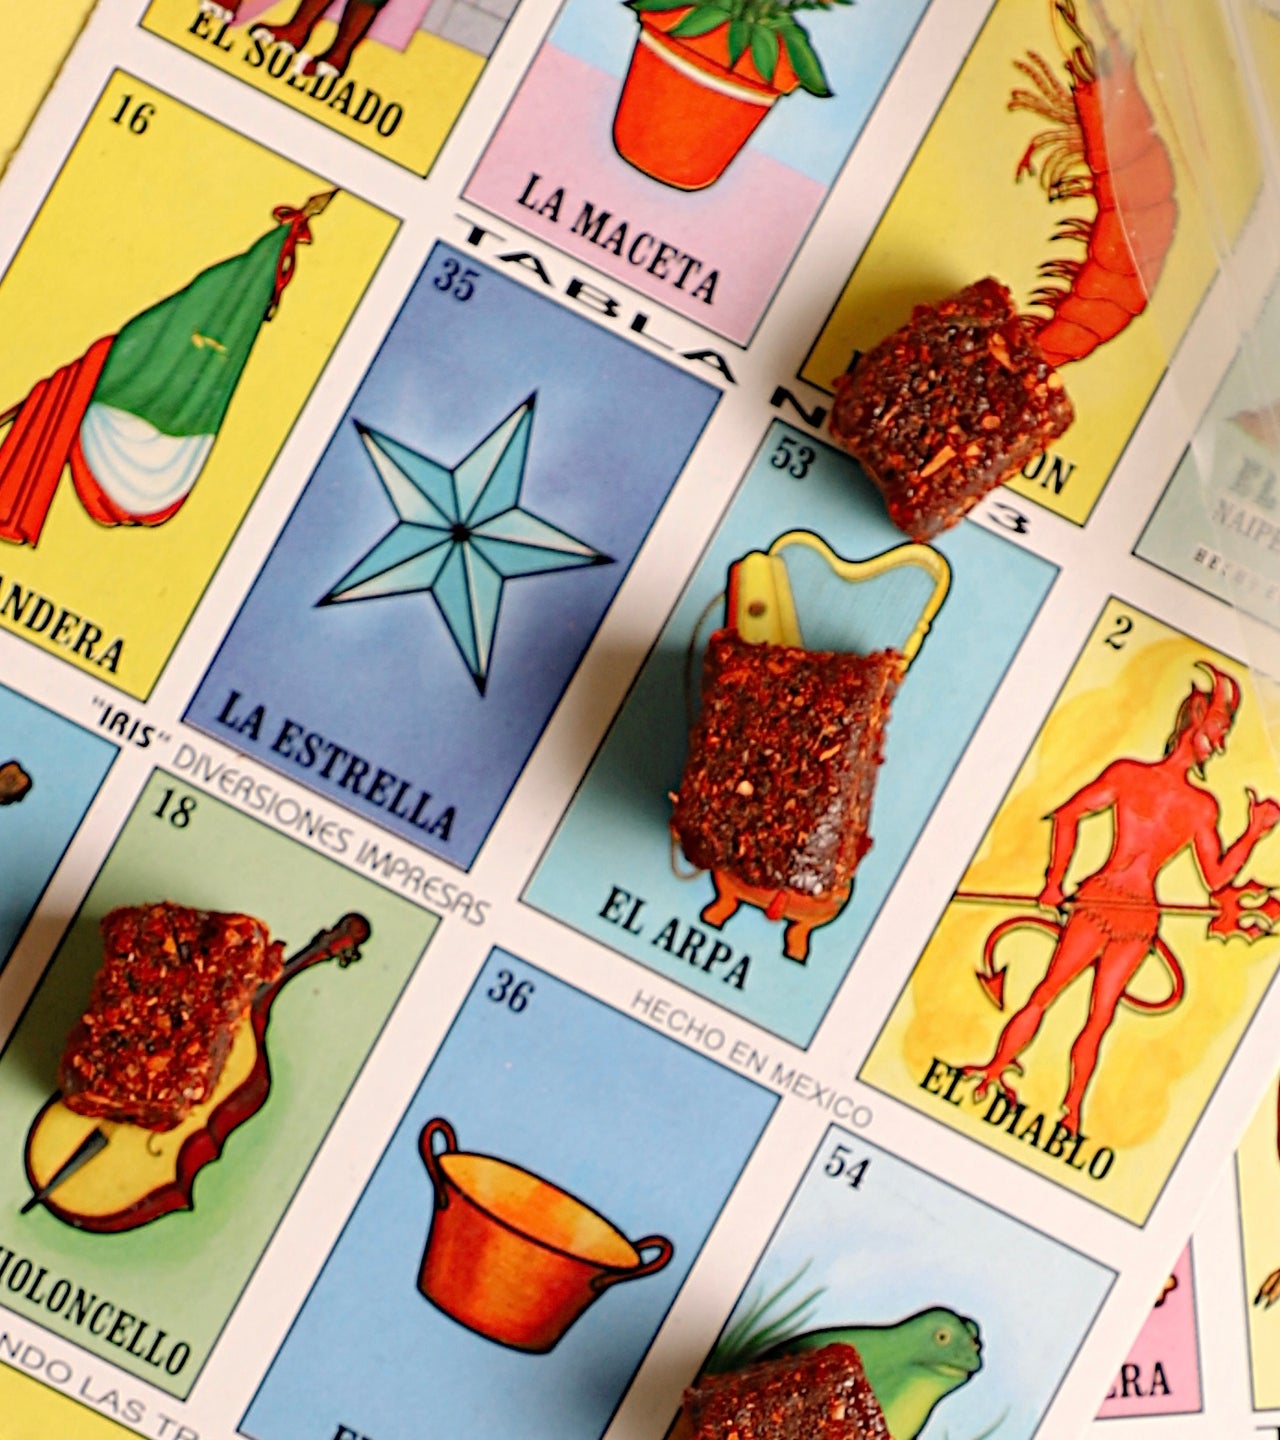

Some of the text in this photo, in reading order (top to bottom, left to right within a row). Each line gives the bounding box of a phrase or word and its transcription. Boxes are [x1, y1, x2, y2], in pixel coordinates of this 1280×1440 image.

[187, 7, 238, 52] EL
[109, 94, 156, 136] 16
[517, 171, 722, 307] LA MACETA
[432, 258, 479, 304] 35
[769, 435, 815, 480] 53
[1104, 615, 1132, 651] 2
[216, 690, 458, 842] LA ESTRELLA
[154, 789, 198, 830] 18
[172, 743, 492, 926] DIVERSIONES IMPRESAS
[599, 885, 750, 991] EL ARPA
[486, 969, 531, 1012] 36
[631, 988, 874, 1130] HECHO EN MEXICO
[823, 1145, 870, 1190] 54
[79, 1374, 143, 1426] LAS
